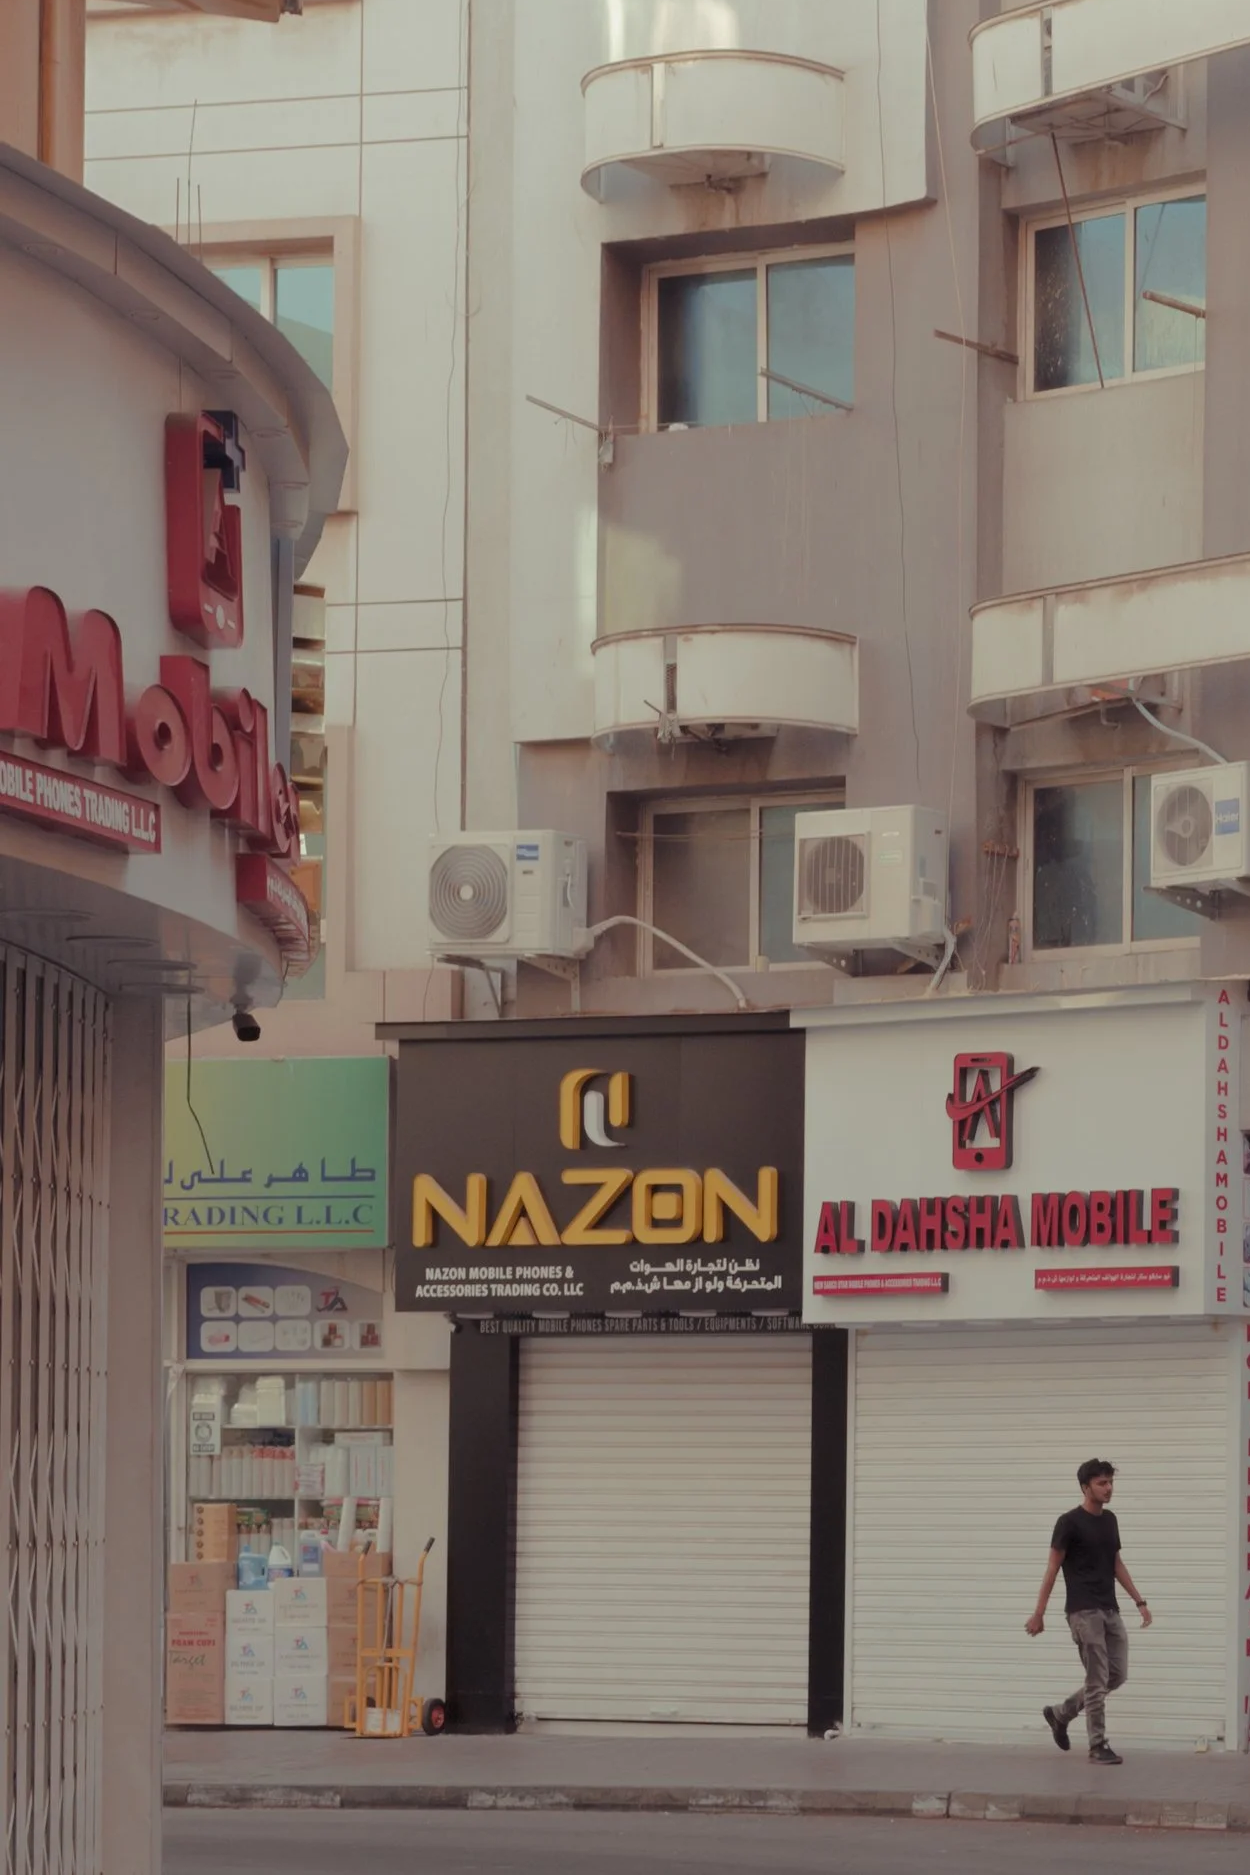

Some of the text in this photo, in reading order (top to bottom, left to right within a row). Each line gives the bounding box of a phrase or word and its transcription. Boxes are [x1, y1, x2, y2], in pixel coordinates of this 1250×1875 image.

[0, 760, 33, 804] OBILE
[36, 772, 82, 820] PHONES
[83, 787, 130, 835] TRADING
[163, 1203, 374, 1227] RADING L.L.C
[411, 1165, 779, 1248] NAZON
[813, 1187, 1180, 1254] AL DAHSHA MOBILE
[425, 1265, 574, 1281] NAZON MOBILE PHONES &
[415, 1282, 584, 1298] ACCESSORIES TRADING CO. LLC
[480, 1320, 500, 1333] BEST
[502, 1319, 536, 1333] QUALITY
[538, 1319, 569, 1333] MOBILE
[570, 1319, 602, 1332] PHONES
[604, 1318, 629, 1331] SPARE
[632, 1317, 658, 1331] PARTS
[668, 1317, 694, 1331] TOOLS
[704, 1317, 757, 1331] EQUIPMENTS
